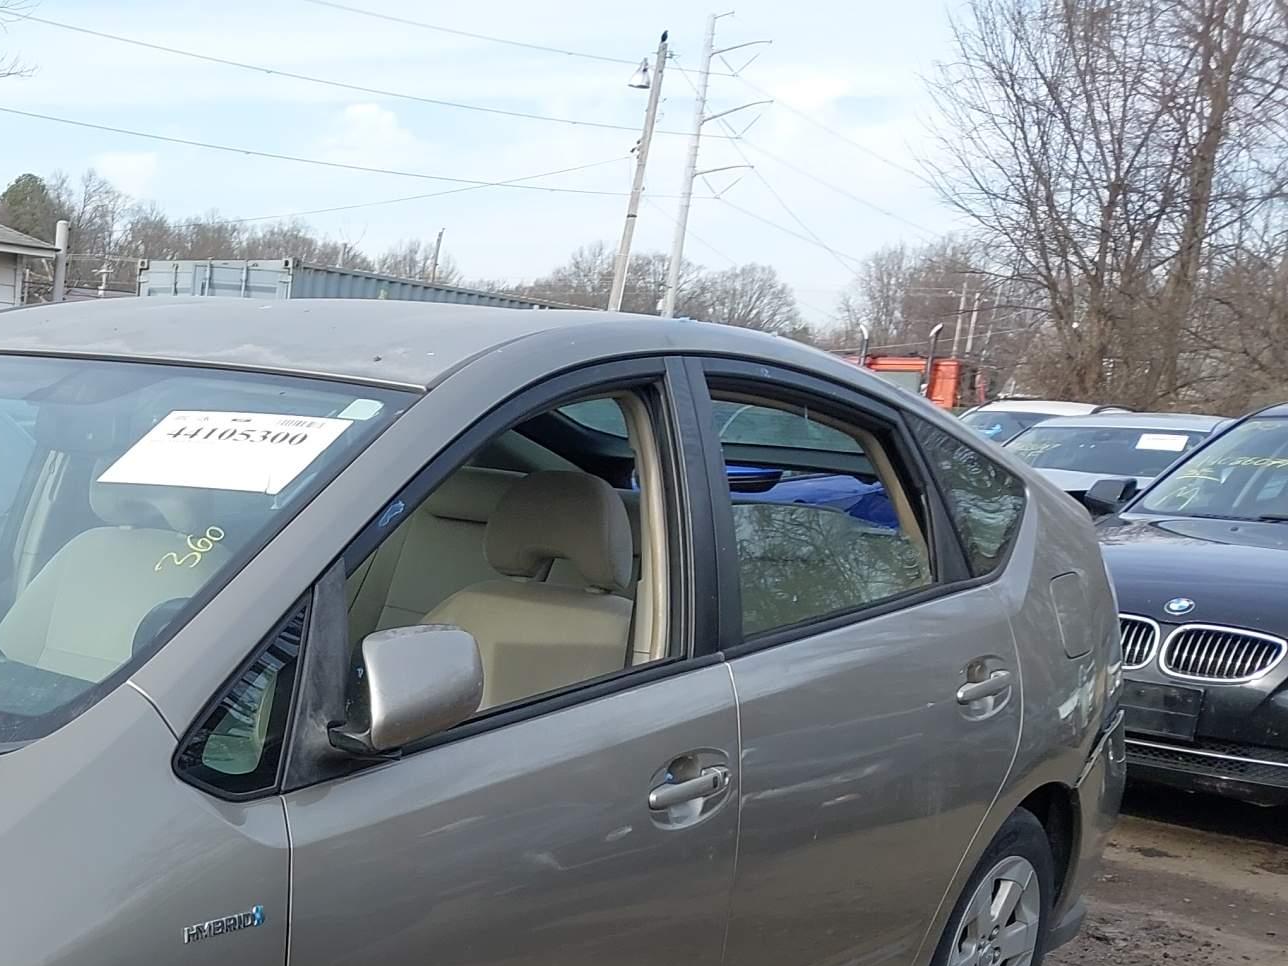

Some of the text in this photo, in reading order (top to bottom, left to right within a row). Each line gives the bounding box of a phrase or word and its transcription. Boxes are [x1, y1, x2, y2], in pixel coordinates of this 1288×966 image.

[167, 426, 308, 446] 44105300
[154, 526, 225, 572] 360
[184, 912, 253, 944] HYBRID
